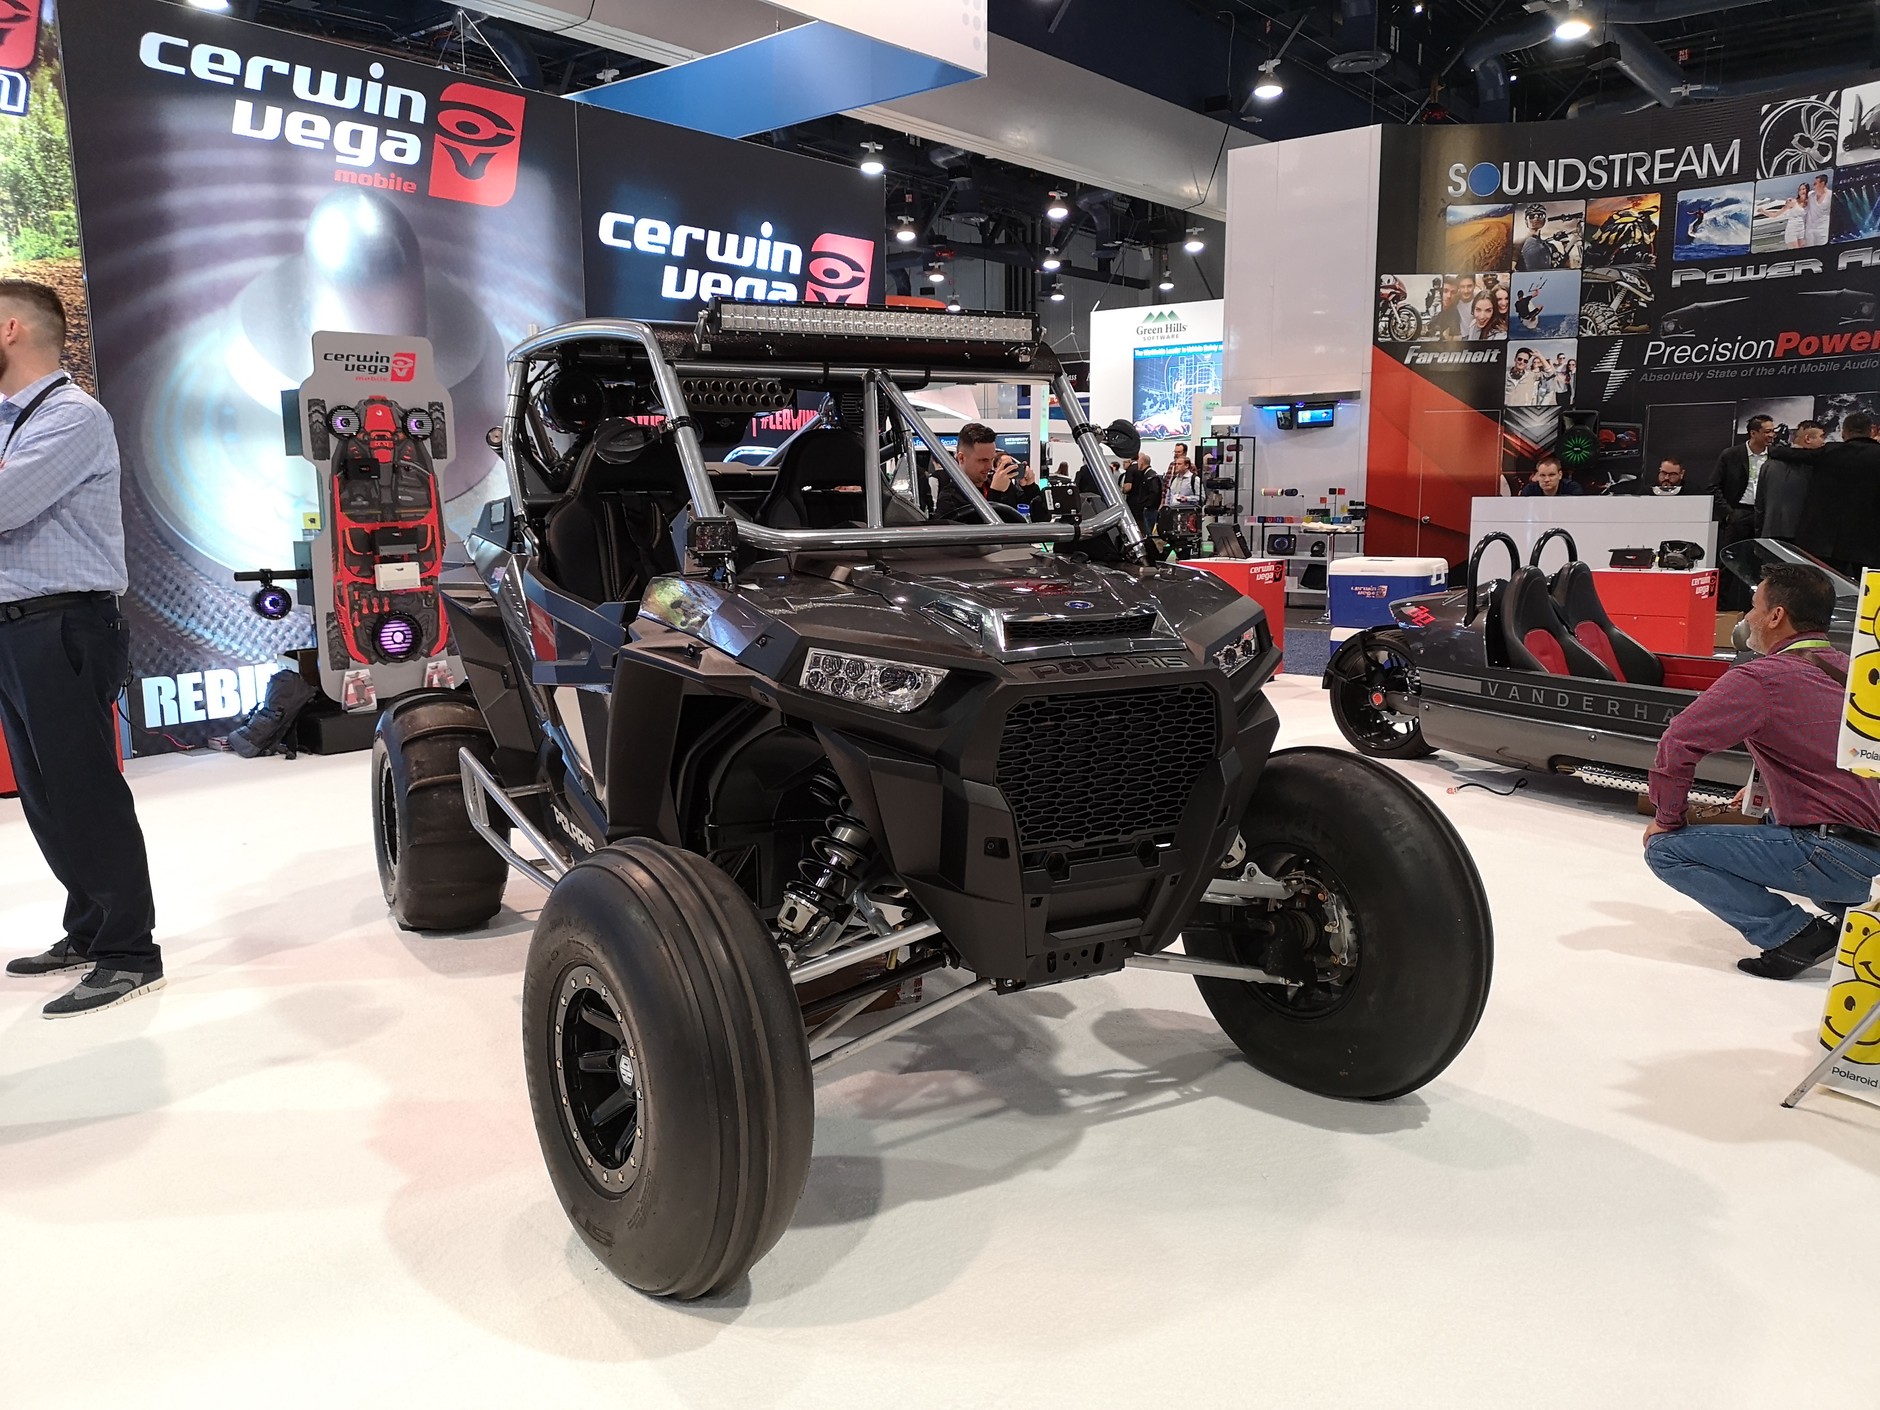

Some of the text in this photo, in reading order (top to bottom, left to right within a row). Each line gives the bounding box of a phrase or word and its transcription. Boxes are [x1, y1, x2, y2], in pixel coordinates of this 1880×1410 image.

[139, 31, 426, 124] cerwin
[231, 98, 422, 168] vega
[1447, 138, 1741, 198] SOUNDSTREAM
[334, 169, 417, 194] mobile
[598, 211, 803, 276] cerwin
[1671, 258, 1824, 288] POWER
[1136, 322, 1187, 336] Green Hills
[1142, 333, 1180, 342] SOFTWARE
[323, 351, 390, 363] cerwin
[1403, 345, 1501, 365] Farenheit
[345, 363, 389, 375] vega
[1639, 359, 1879, 383] Absolutely State of the Art Mobile Audio
[1250, 562, 1275, 574] cerwin
[1256, 572, 1274, 582] vega
[1030, 655, 1190, 680] POLARIS
[1488, 682, 1675, 723] VANDERHA
[1831, 1066, 1879, 1088] Polaroid
